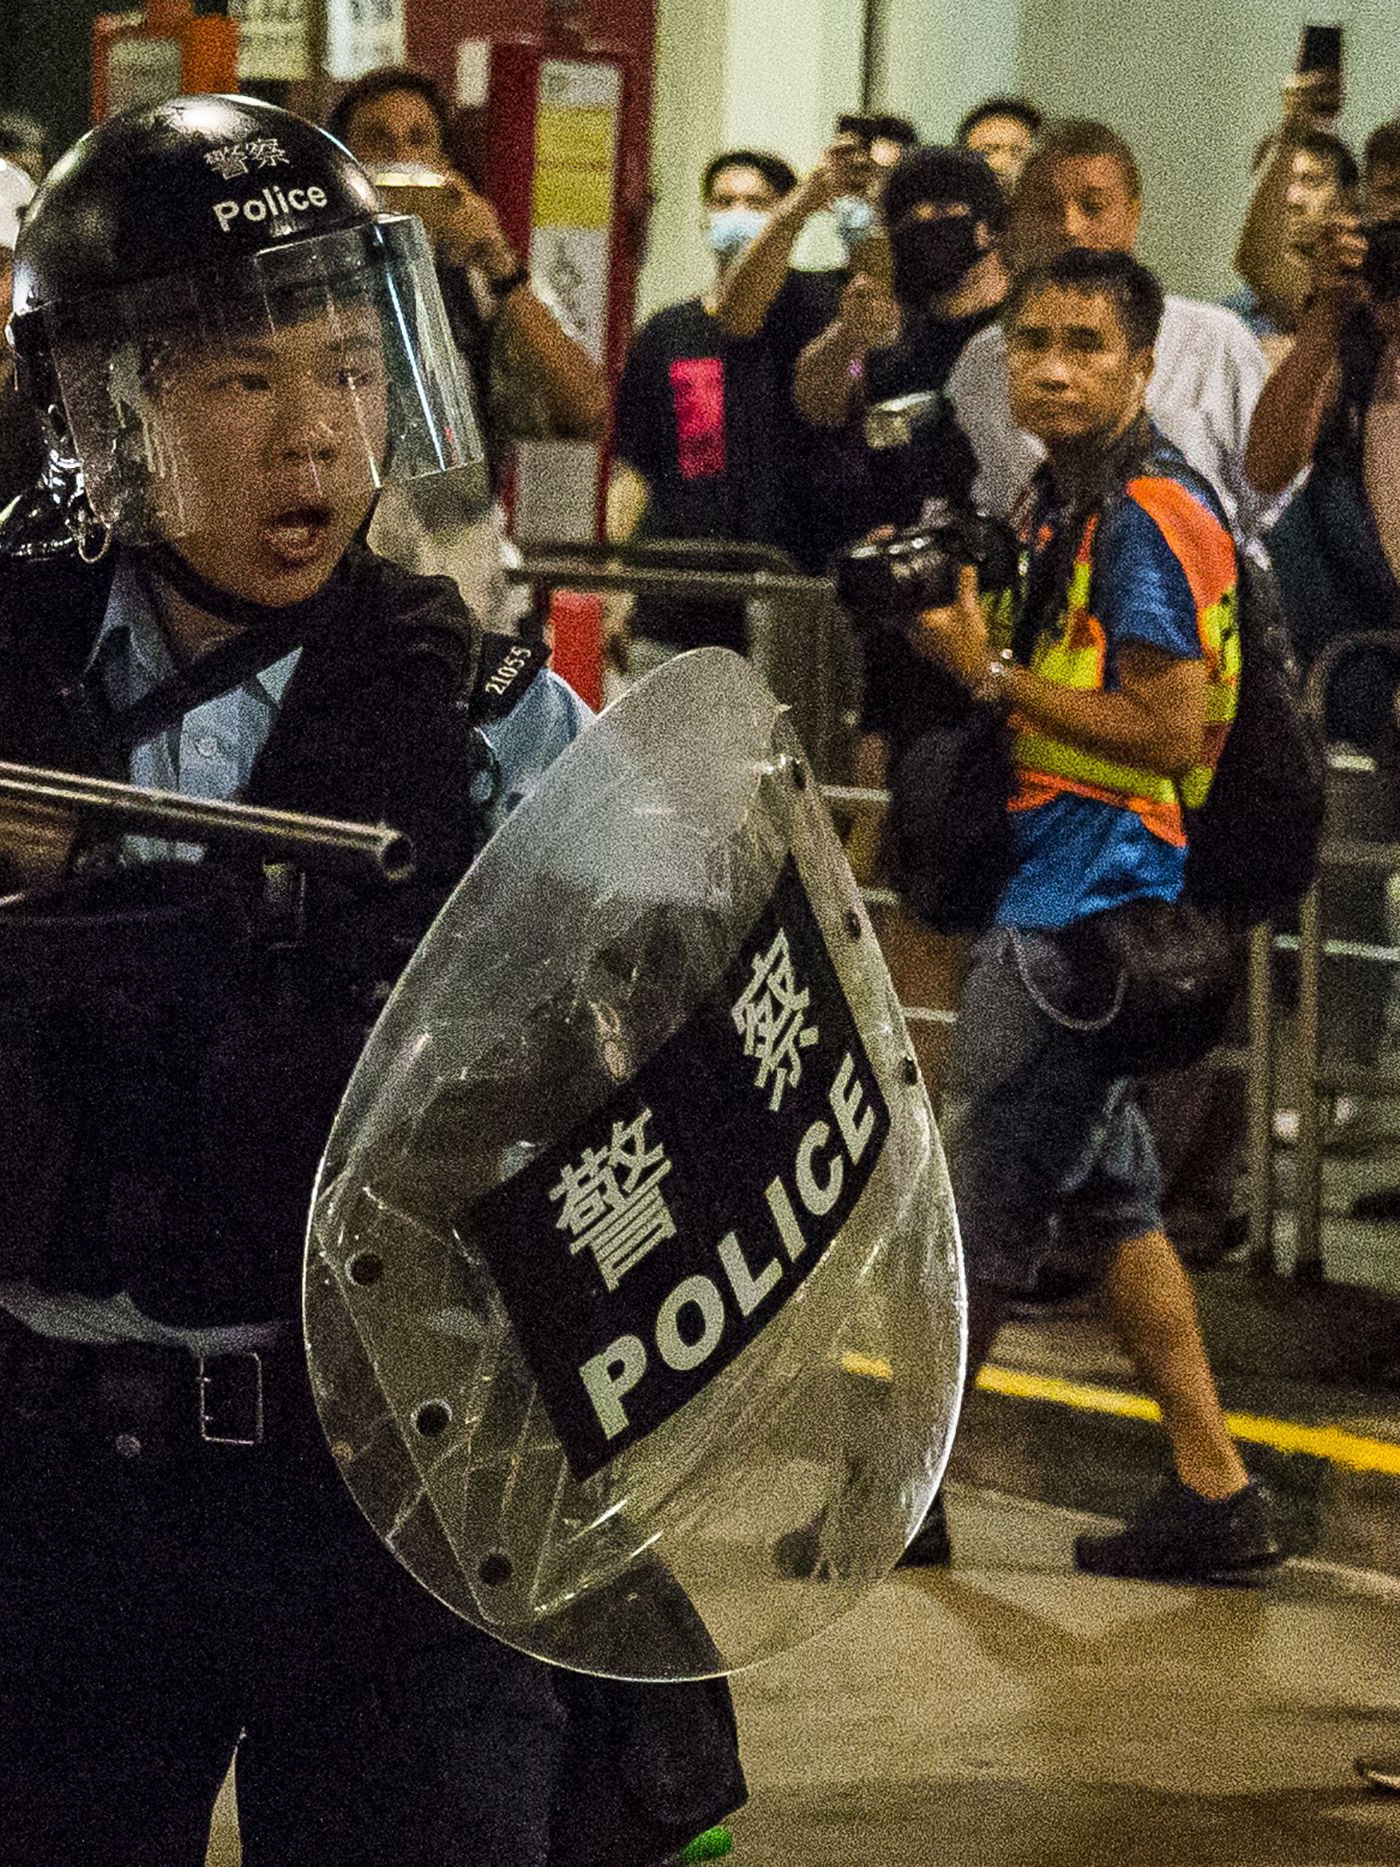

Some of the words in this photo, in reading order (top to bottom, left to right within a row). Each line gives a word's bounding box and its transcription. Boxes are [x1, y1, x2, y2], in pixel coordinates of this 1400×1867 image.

[203, 138, 290, 180] 警察
[213, 185, 328, 232] Police
[485, 646, 531, 695] 21055
[579, 1053, 876, 1439] POLICE
